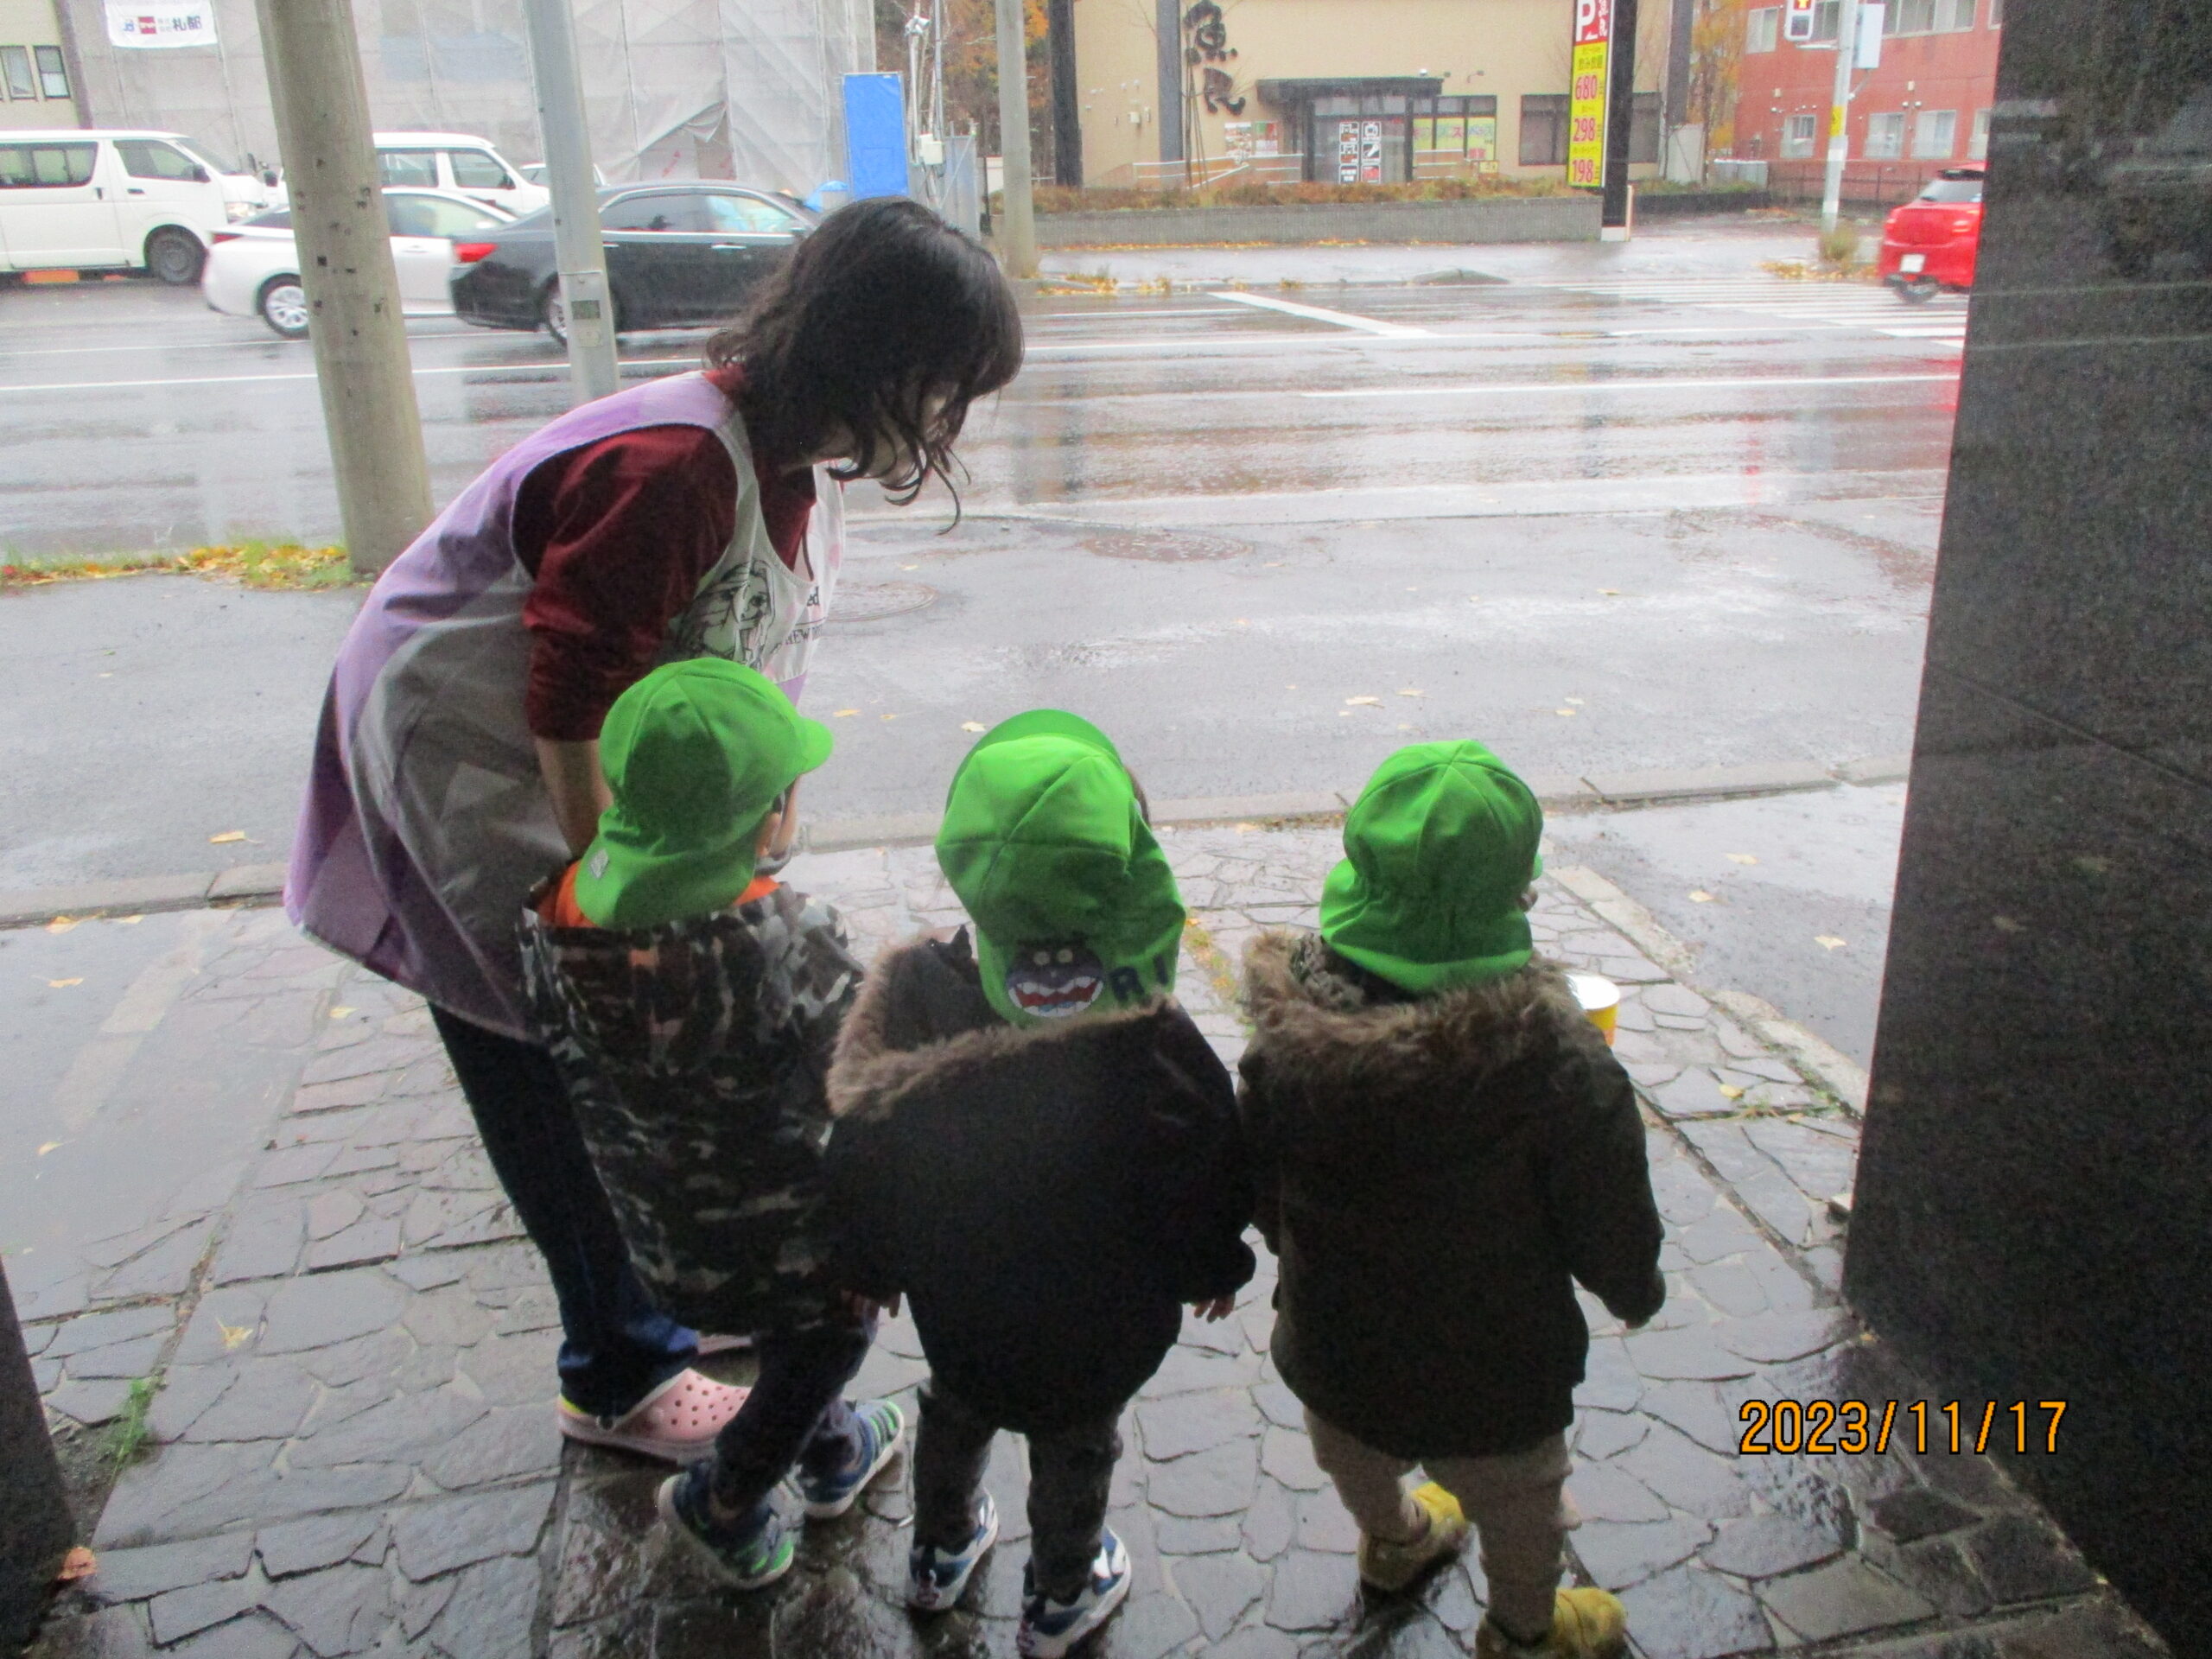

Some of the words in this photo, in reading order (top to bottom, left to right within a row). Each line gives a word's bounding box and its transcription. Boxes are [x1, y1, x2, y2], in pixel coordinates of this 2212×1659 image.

[1575, 0, 1597, 41] P
[1575, 75, 1597, 99] 680
[1573, 117, 1595, 142] 298
[1572, 159, 1593, 182] 198
